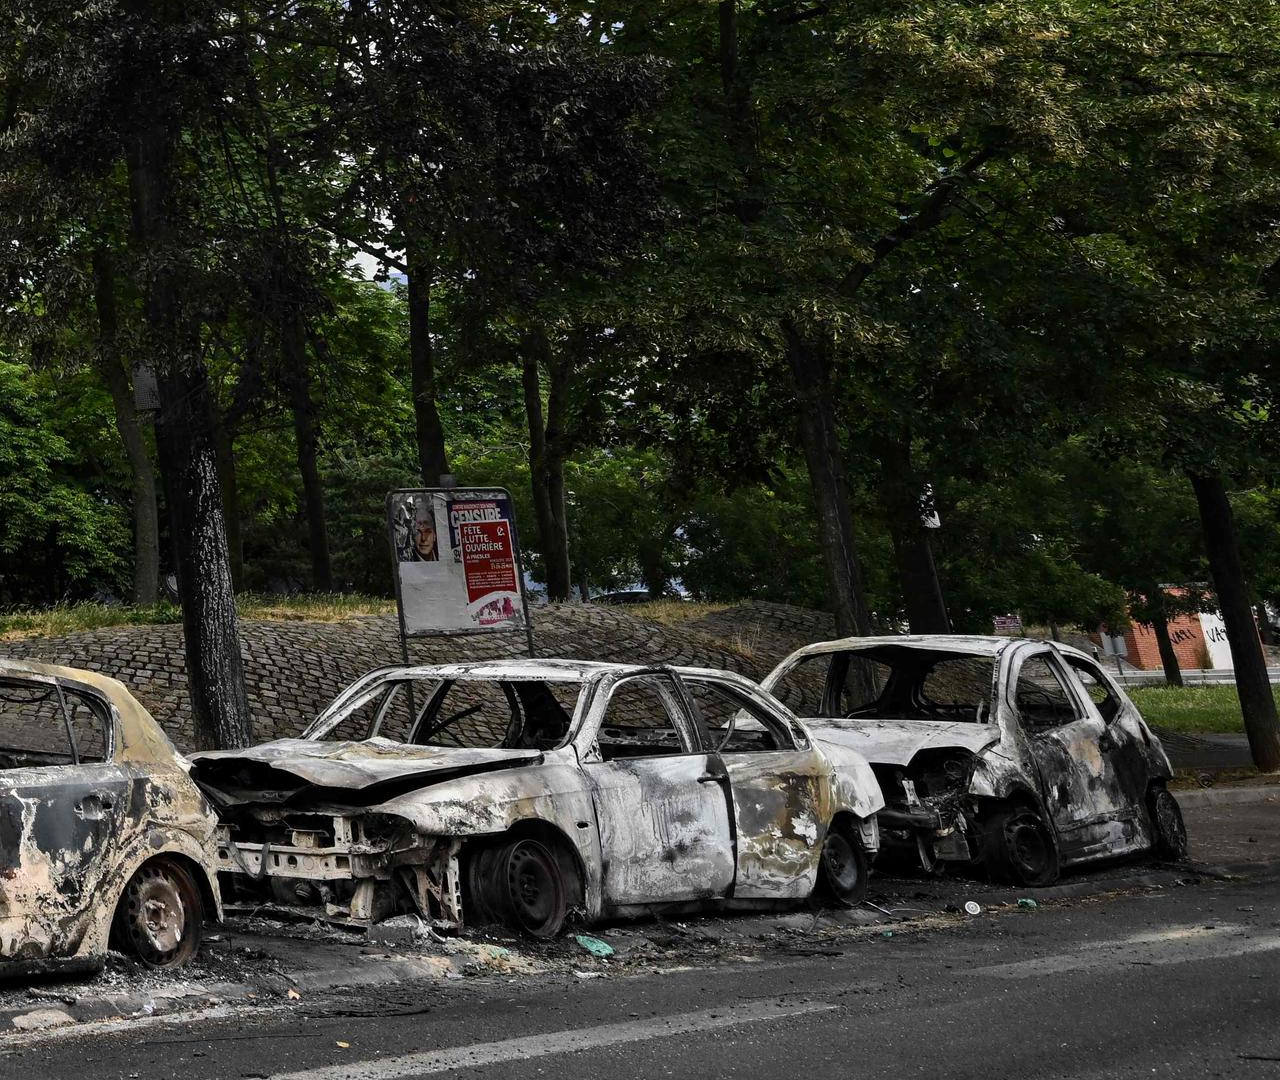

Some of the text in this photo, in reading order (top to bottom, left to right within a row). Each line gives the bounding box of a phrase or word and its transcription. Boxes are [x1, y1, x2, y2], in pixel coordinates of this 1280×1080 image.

[464, 524, 481, 534] FÊTE
[465, 535, 489, 543] LUTTE
[465, 541, 503, 552] OUVRIÈRE
